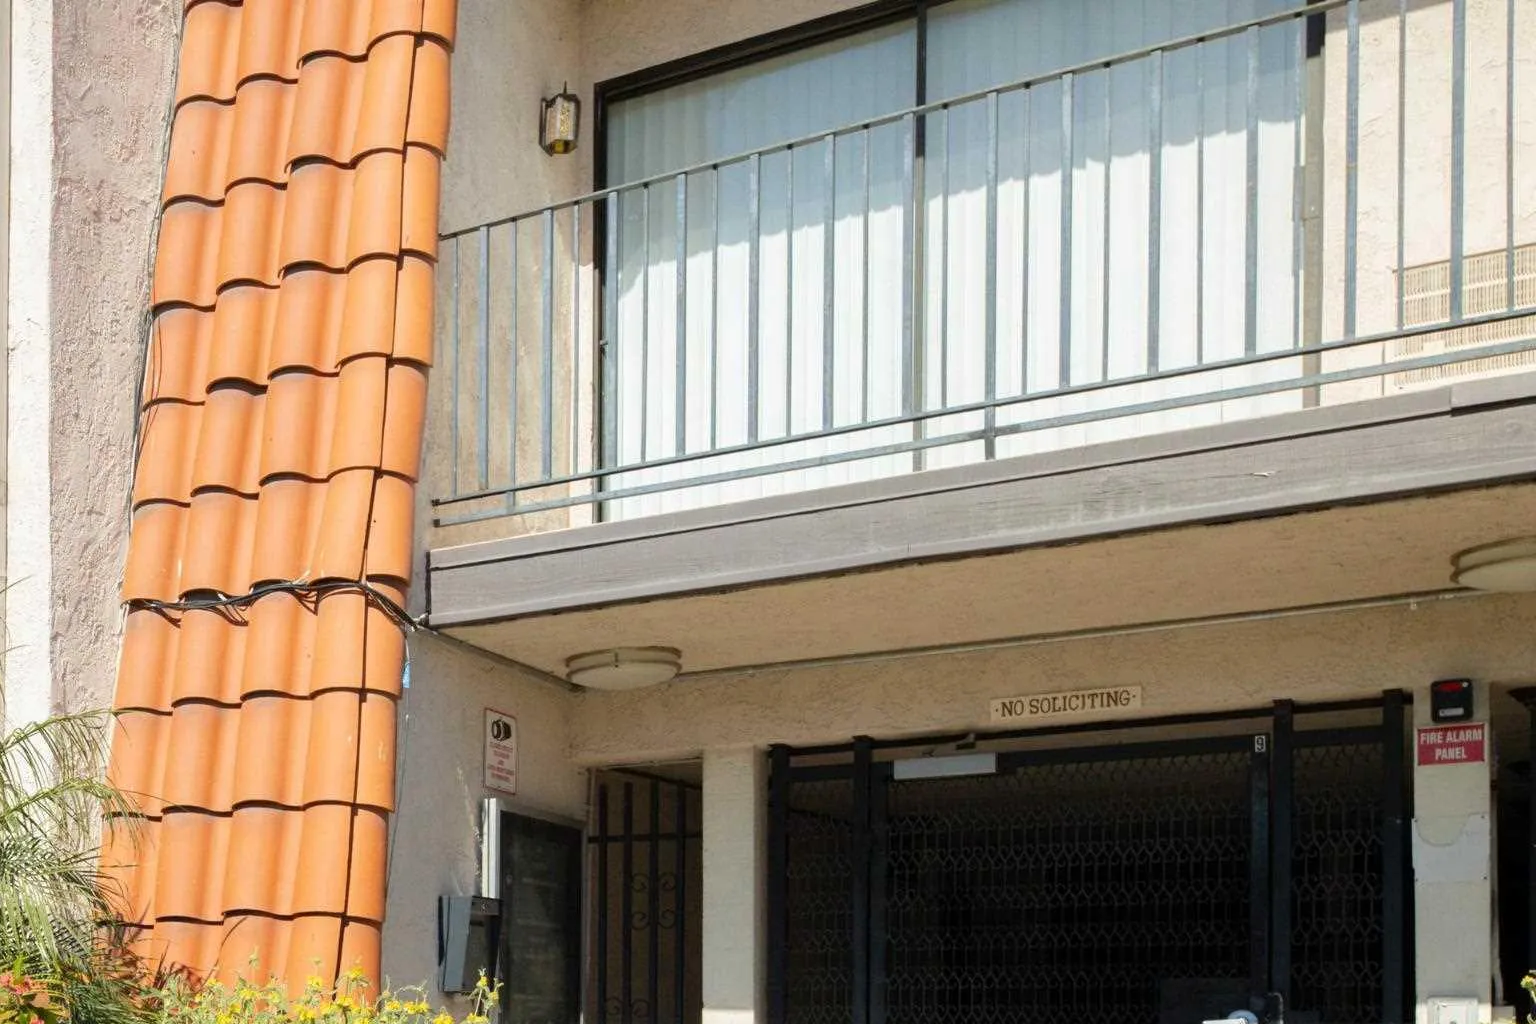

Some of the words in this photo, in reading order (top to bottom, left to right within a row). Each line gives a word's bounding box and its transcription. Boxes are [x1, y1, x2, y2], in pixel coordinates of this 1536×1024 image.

[1001, 701, 1024, 717] NO
[1029, 690, 1130, 714] SOLICITING
[1420, 730, 1444, 745] FIRE
[1445, 728, 1482, 743] ALARM
[1434, 747, 1468, 760] PANEL
